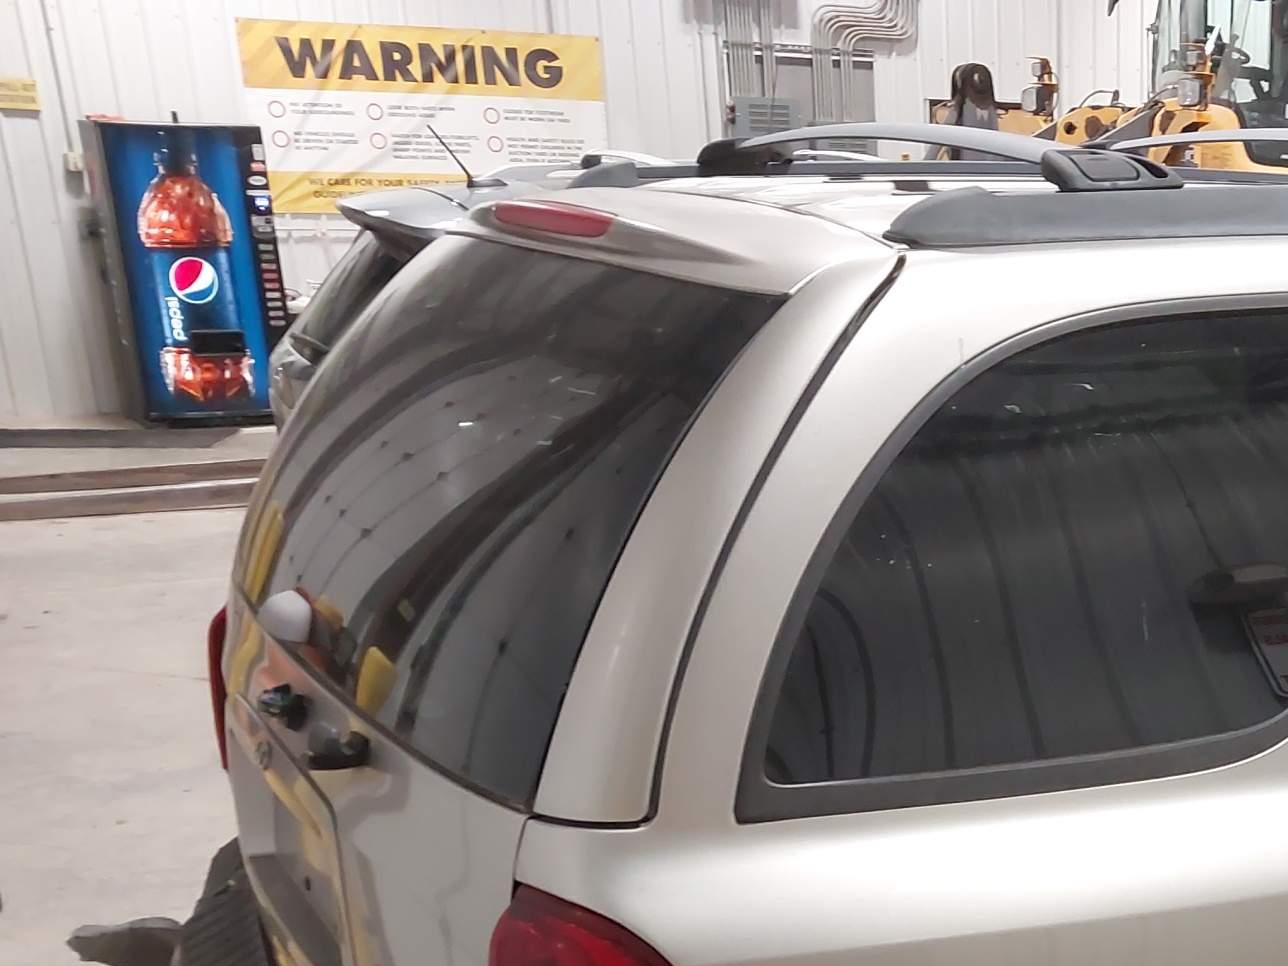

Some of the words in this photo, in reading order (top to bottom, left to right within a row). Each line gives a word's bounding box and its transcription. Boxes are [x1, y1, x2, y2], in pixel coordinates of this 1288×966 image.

[275, 36, 564, 89] WARNING
[327, 178, 351, 186] CARE
[377, 179, 404, 187] YOUR
[164, 296, 188, 341] pepsi
